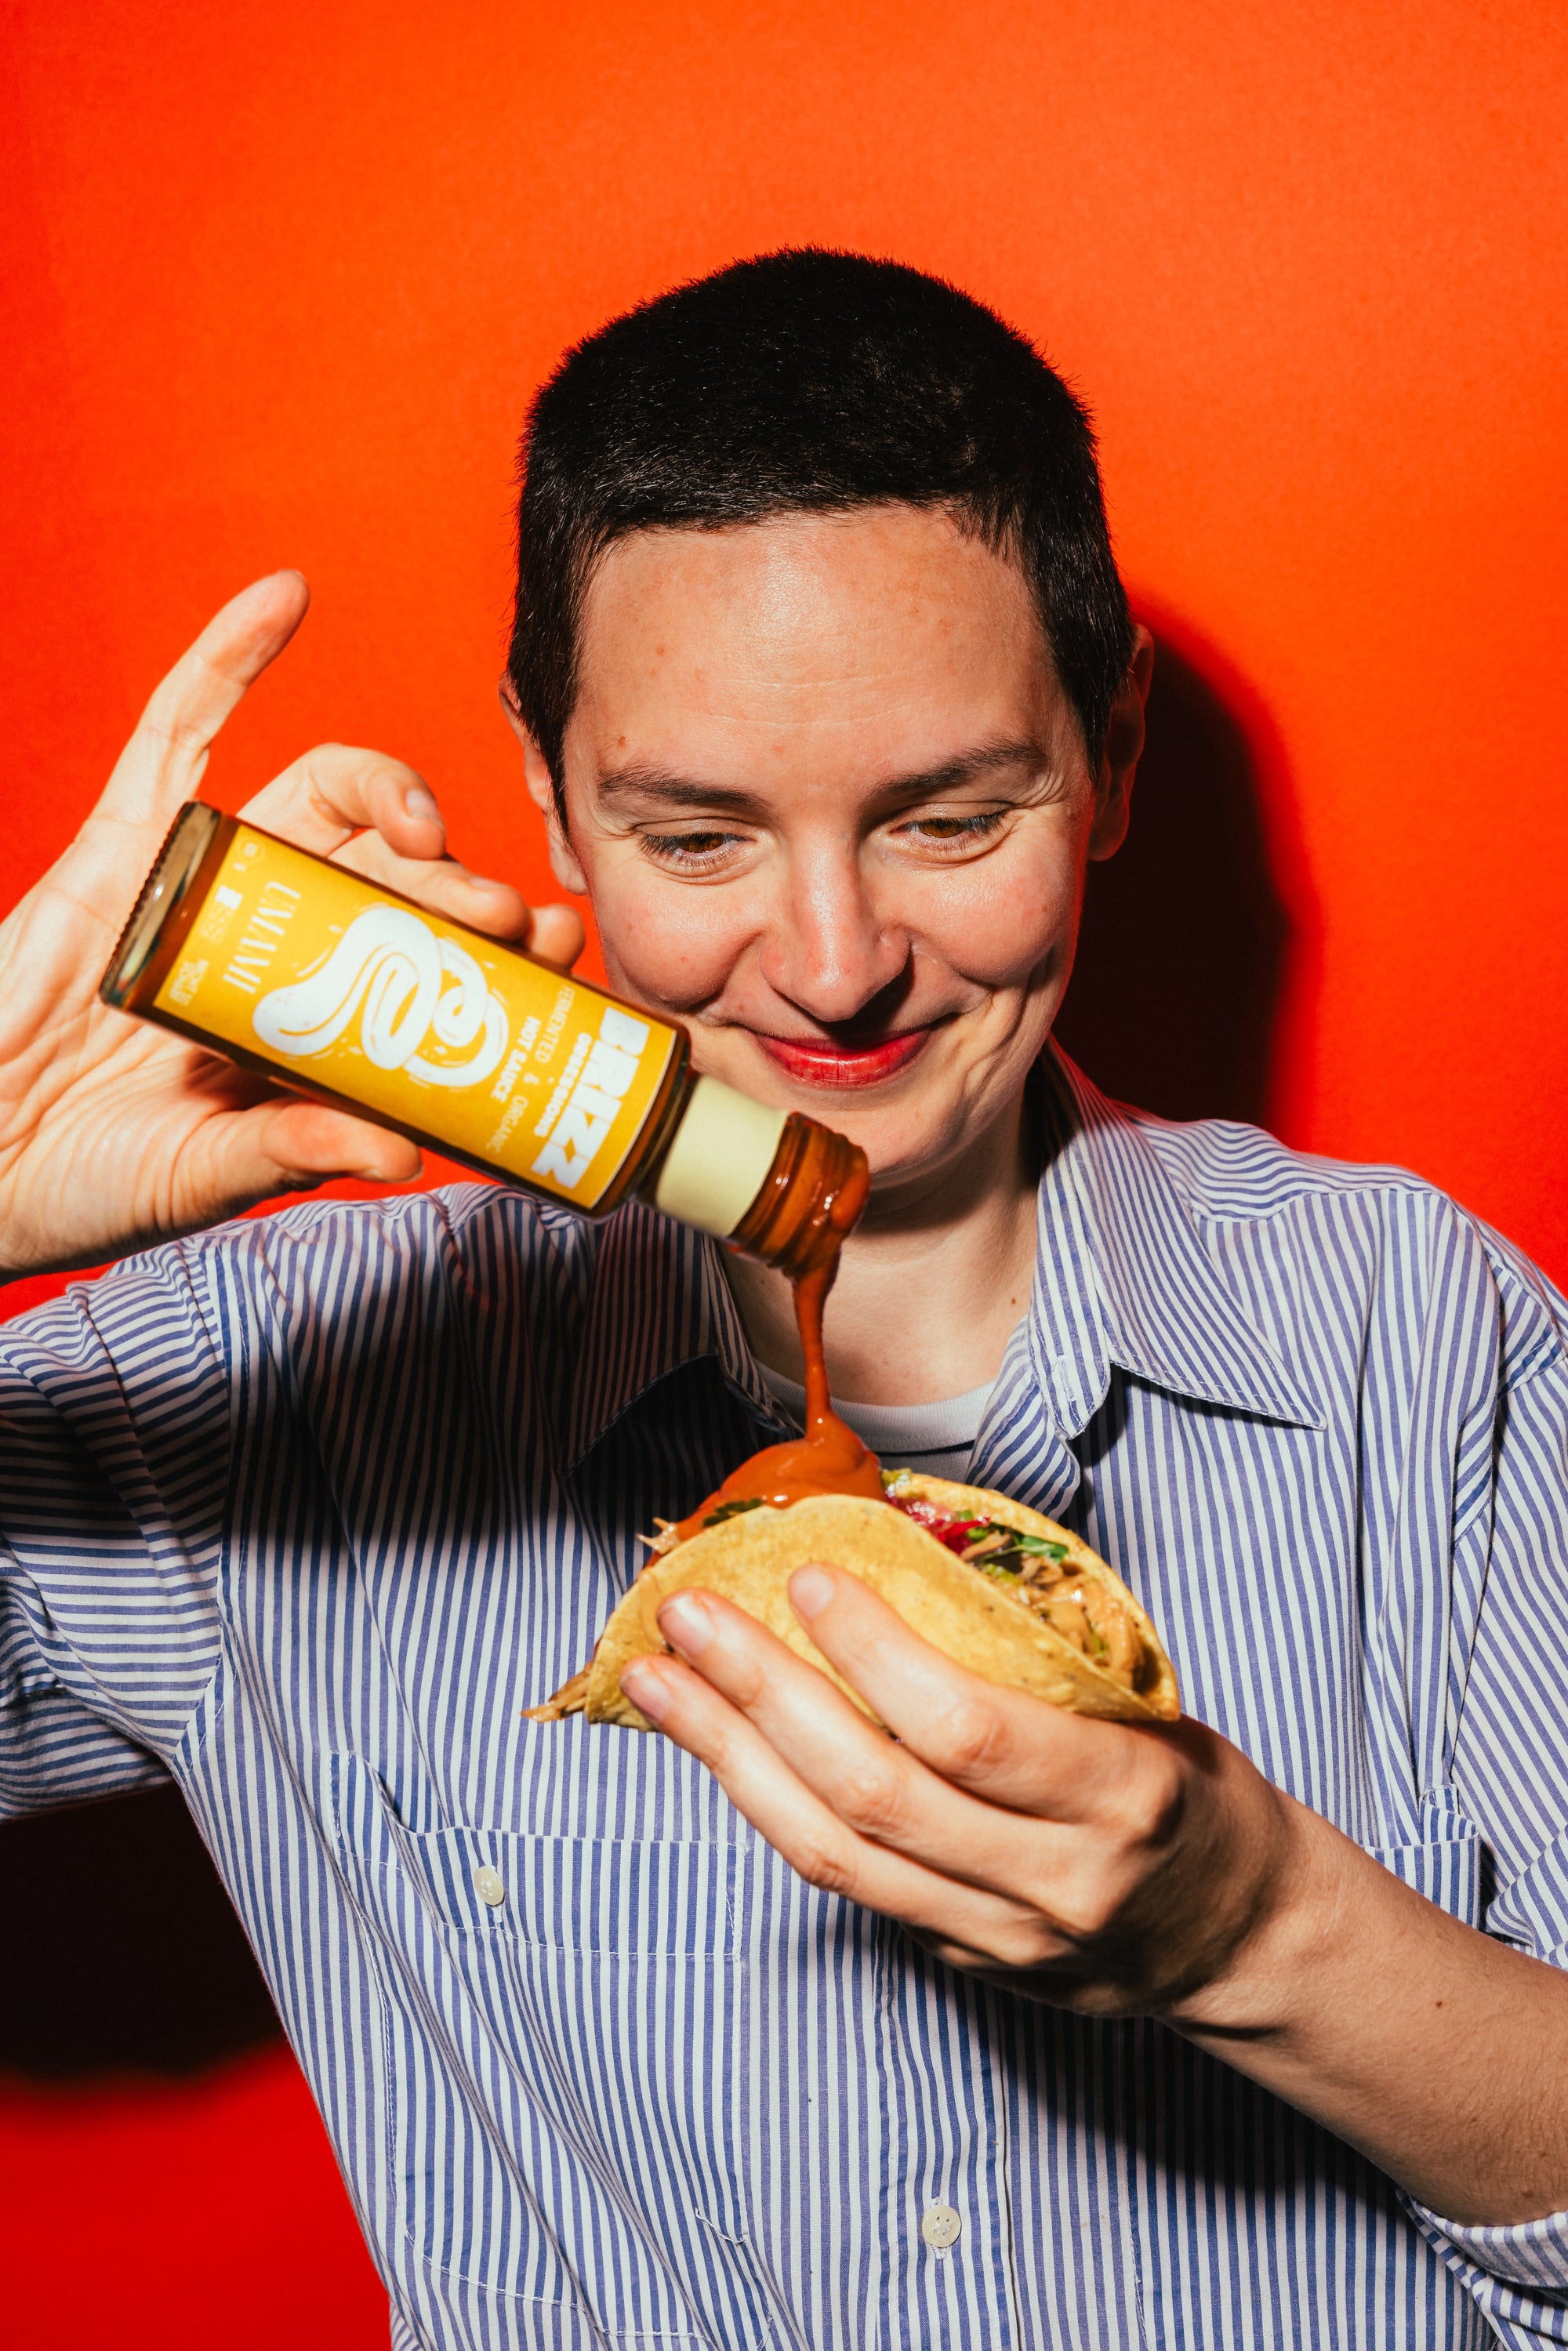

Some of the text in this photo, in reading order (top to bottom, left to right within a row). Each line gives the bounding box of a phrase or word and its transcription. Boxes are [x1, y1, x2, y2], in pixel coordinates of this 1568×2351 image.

[222, 881, 301, 994] UMAMI
[485, 986, 575, 1153] FERMENTED & ORGANIC
[490, 1016, 542, 1103] HOT SAUCE
[530, 1007, 649, 1189] BRIZZ
[532, 1032, 593, 1139] OBSESSIONS
